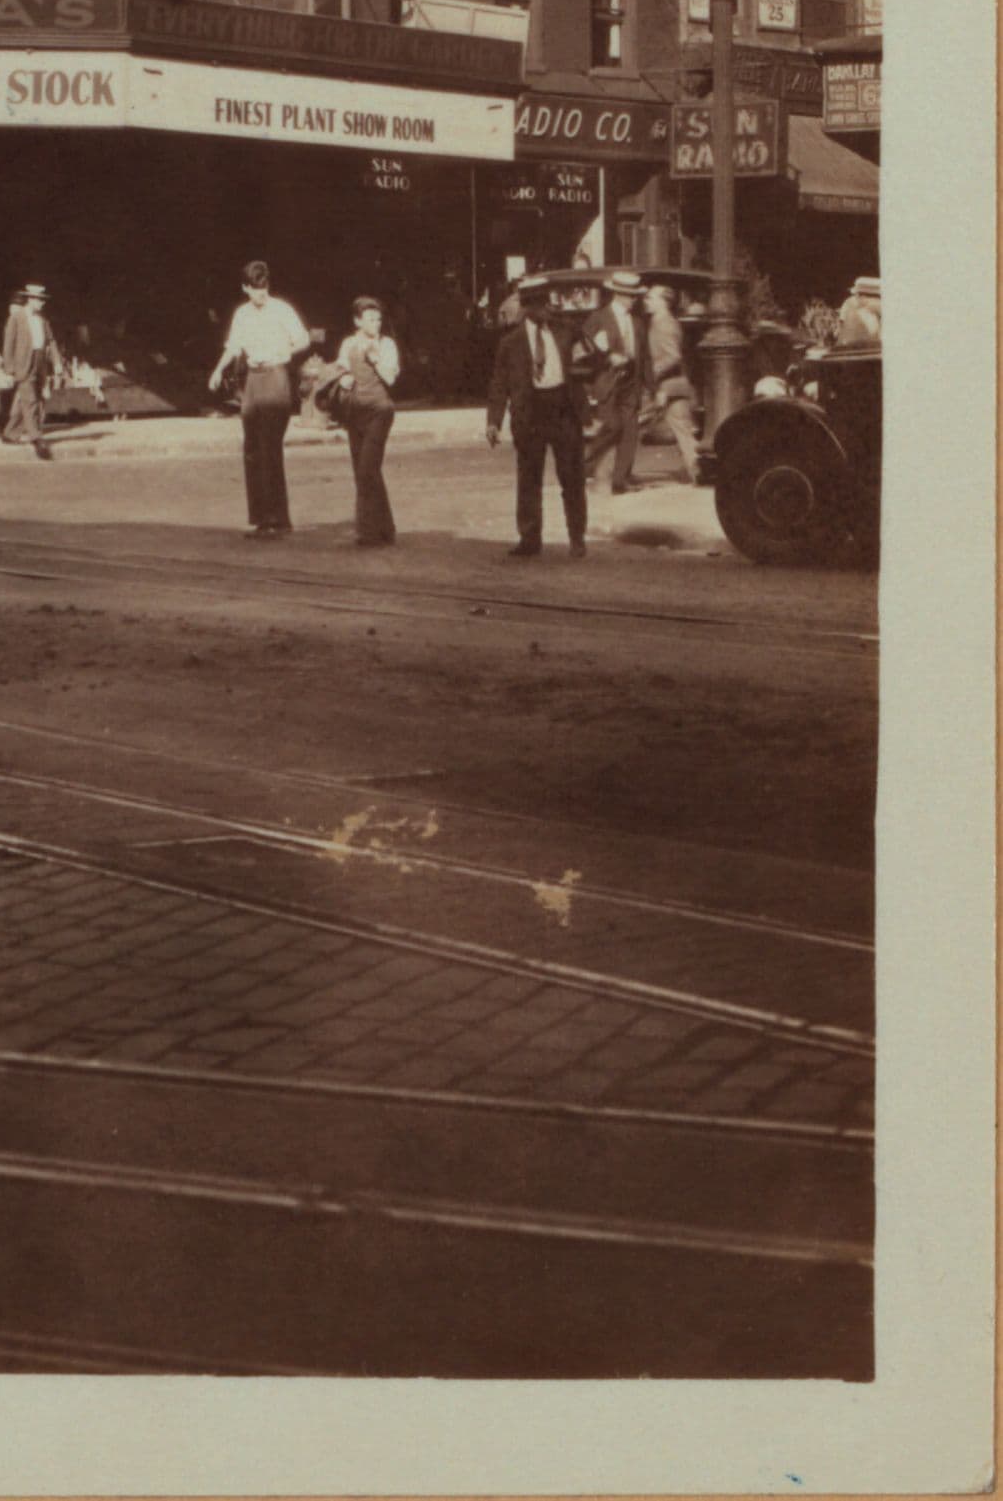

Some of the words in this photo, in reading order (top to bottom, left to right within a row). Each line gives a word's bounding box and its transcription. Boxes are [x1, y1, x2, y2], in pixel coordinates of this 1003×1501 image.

[317, 19, 359, 57] FOR
[364, 24, 405, 61] THE
[6, 68, 116, 108] STOCK
[214, 97, 273, 128] FINEST
[281, 104, 337, 134] PLANT
[342, 110, 387, 138] SHOW
[392, 116, 436, 143] ROOM
[514, 105, 583, 139] ADIO
[594, 110, 633, 144] CO.
[686, 108, 759, 140] SN
[371, 157, 403, 173] SUN
[677, 140, 769, 171] RAIO
[548, 187, 593, 204] RADIO
[556, 173, 584, 187] SUN
